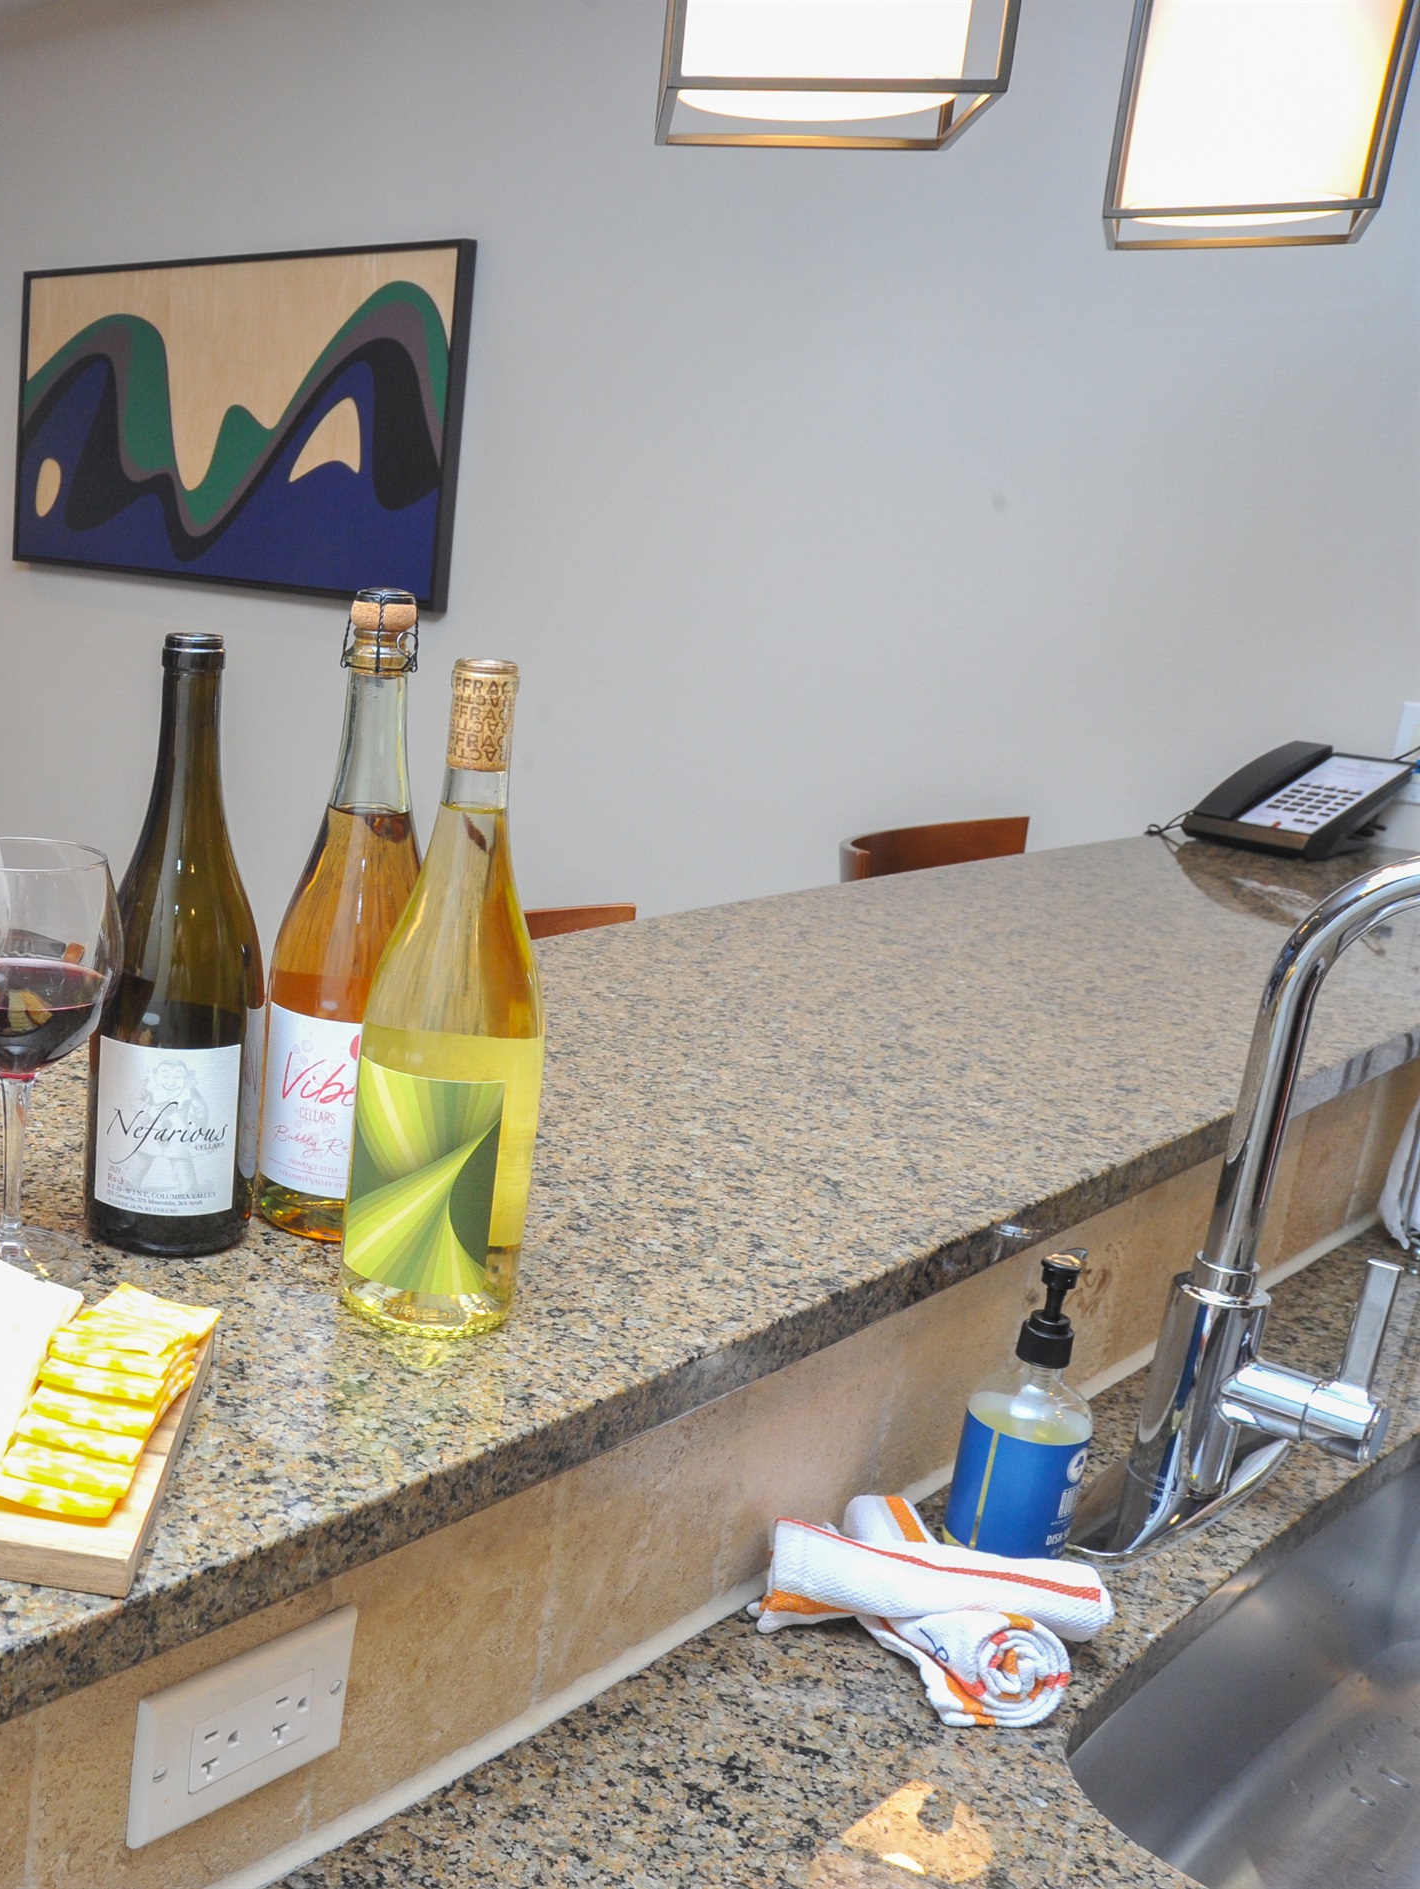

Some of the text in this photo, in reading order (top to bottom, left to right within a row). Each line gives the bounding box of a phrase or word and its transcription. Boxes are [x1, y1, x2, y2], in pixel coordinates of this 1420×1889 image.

[300, 1107, 336, 1125] CELLARS
[107, 1102, 228, 1164] Nefarious
[272, 1125, 324, 1158] Bubbly
[195, 1142, 225, 1151] CELLARS
[279, 1169, 308, 1183] COLUMBIA
[309, 1178, 332, 1187] VALLEY
[107, 1182, 122, 1192] RED
[151, 1192, 190, 1200] COLUMBIA
[191, 1191, 216, 1199] VALLEY
